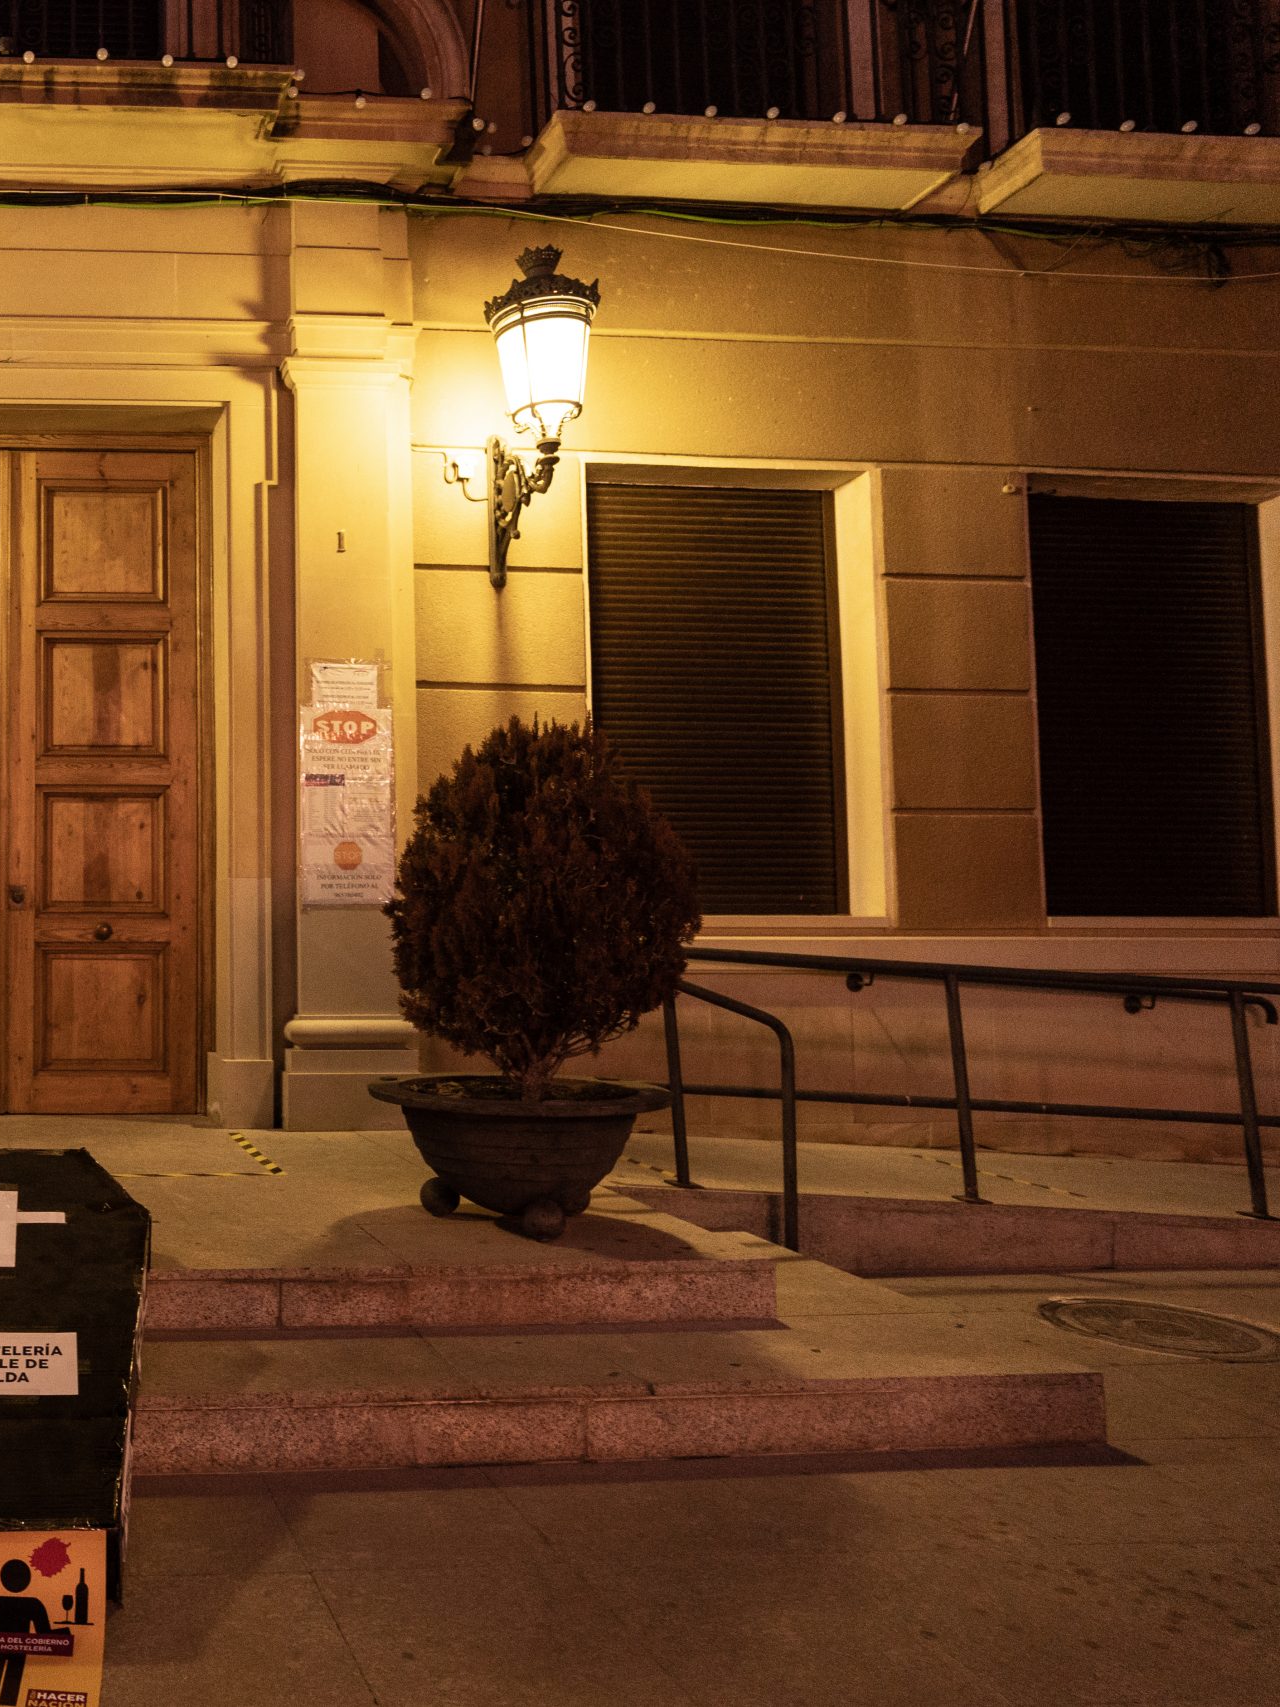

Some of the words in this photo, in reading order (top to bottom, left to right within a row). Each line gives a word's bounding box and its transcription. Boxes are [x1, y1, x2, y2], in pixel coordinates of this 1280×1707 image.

[316, 720, 375, 735] STOP
[25, 1358, 49, 1369] DE
[25, 1638, 70, 1646] GOBIERNO
[37, 1691, 86, 1702] HACER
